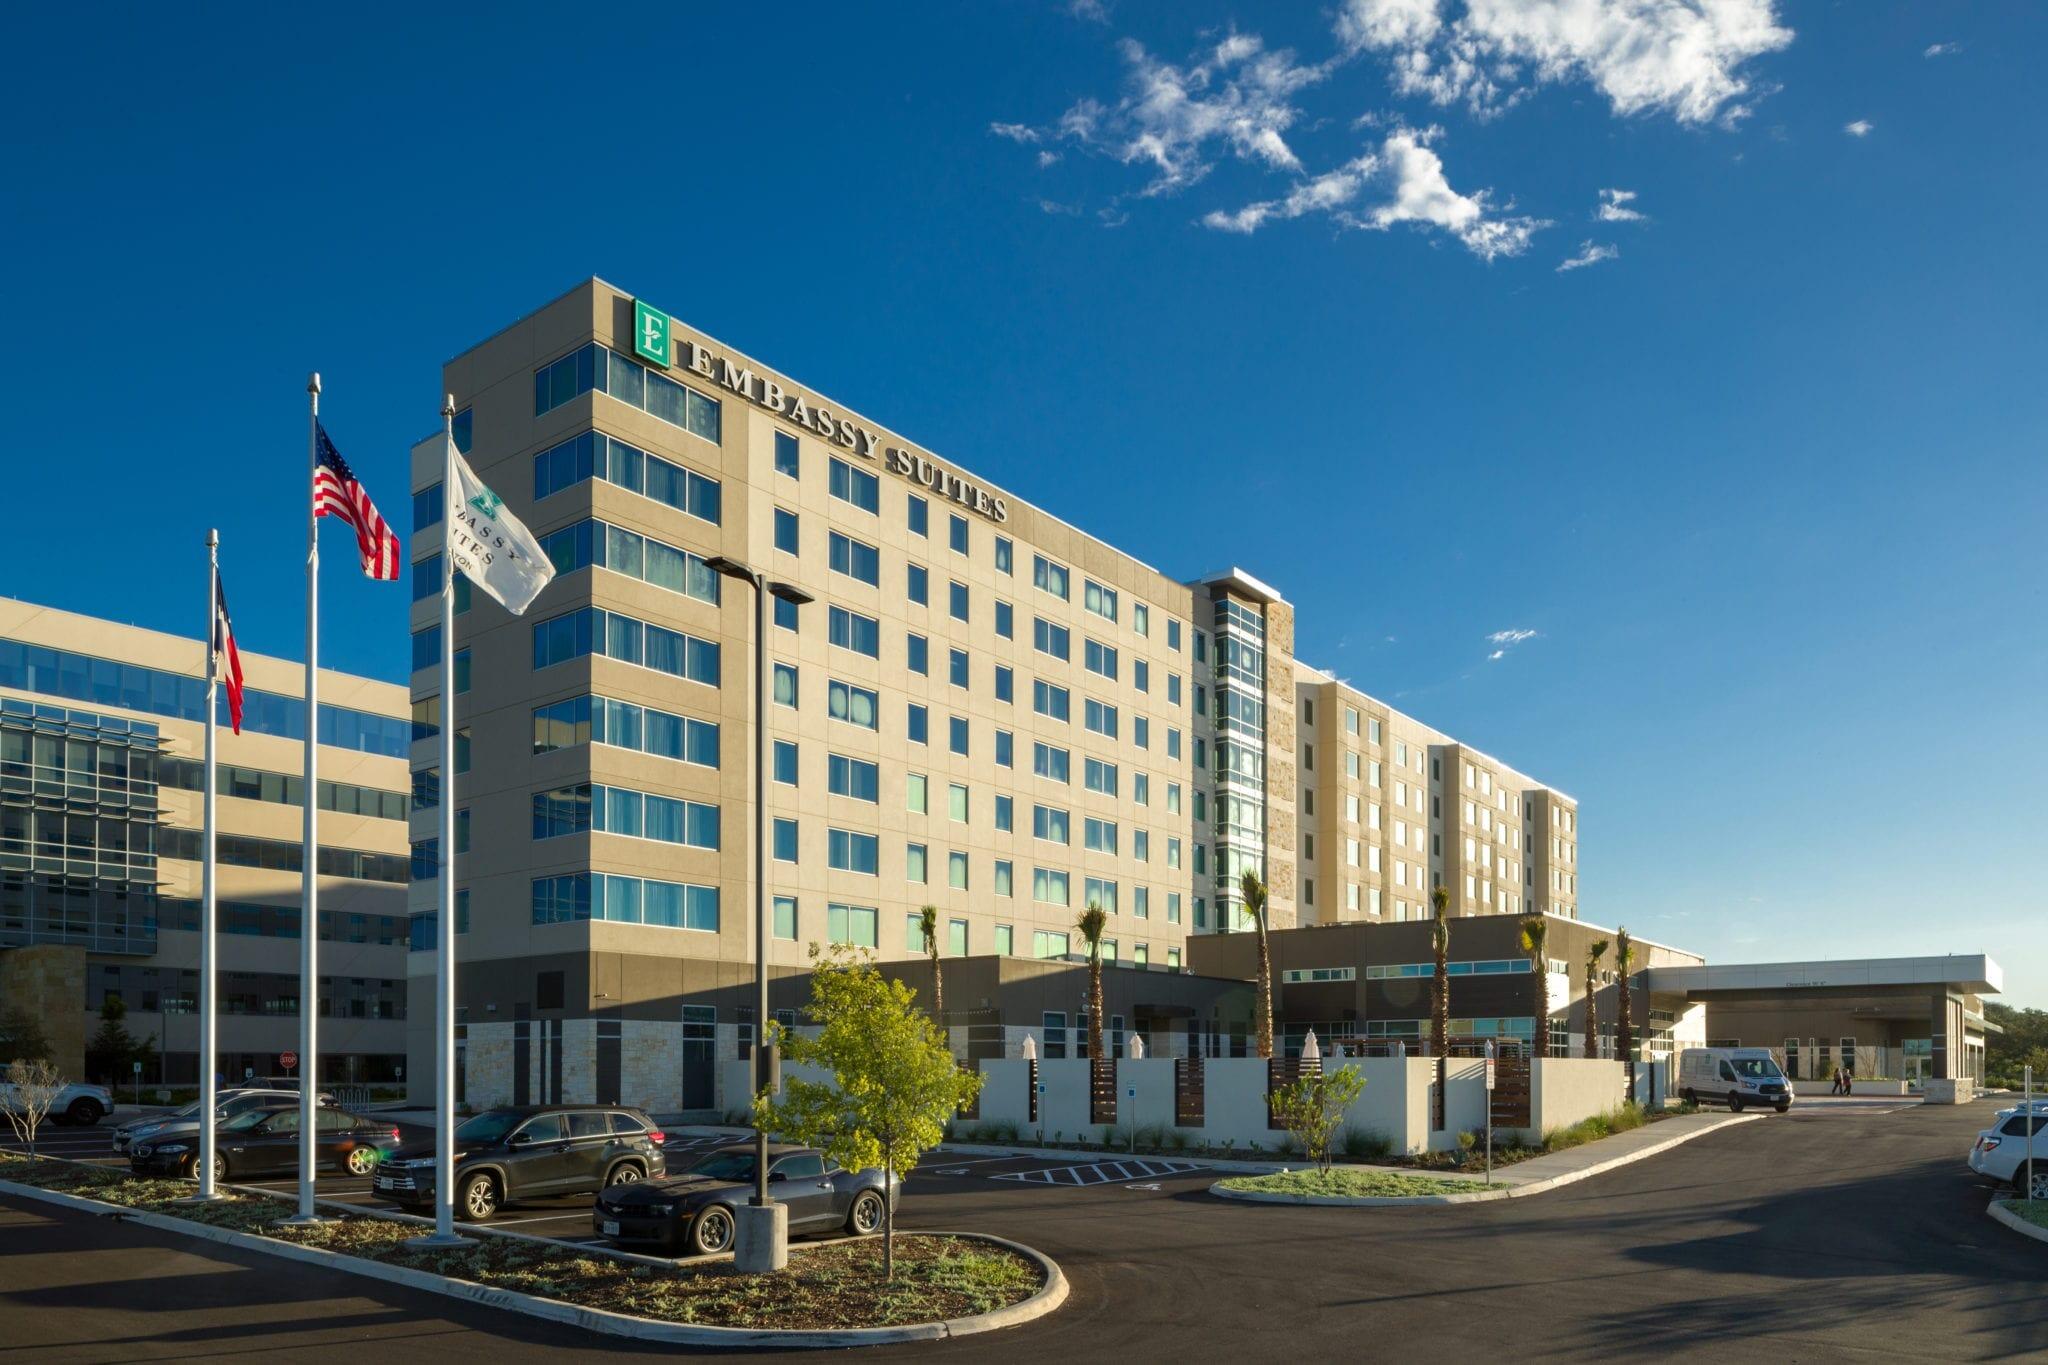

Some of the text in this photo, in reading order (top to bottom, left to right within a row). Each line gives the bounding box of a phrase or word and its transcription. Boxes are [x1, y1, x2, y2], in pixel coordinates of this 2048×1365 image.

[688, 340, 1007, 523] EMBASSY SUITES
[456, 504, 520, 561] BASSY
